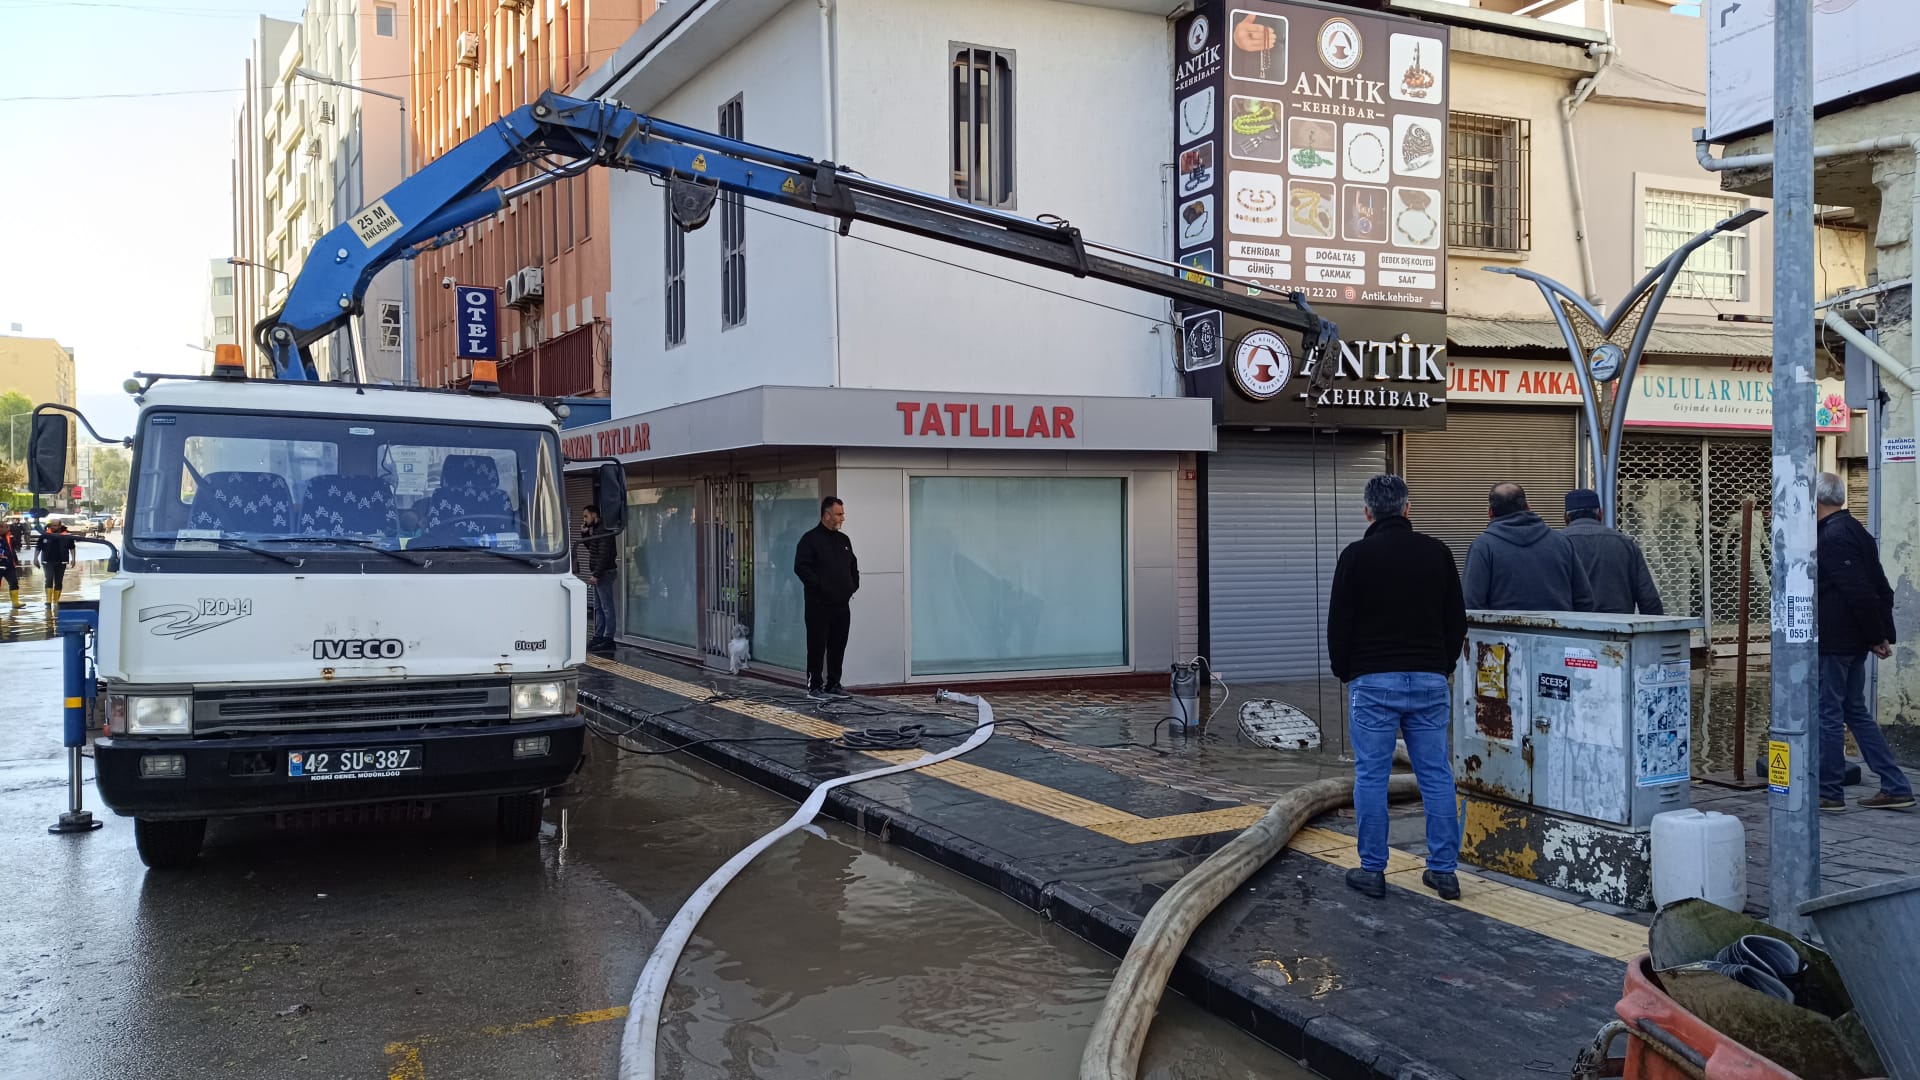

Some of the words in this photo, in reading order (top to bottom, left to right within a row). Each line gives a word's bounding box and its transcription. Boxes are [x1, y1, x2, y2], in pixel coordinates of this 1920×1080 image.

[1176, 44, 1220, 81] ANTİK
[1292, 71, 1386, 104] ANTİK
[1302, 101, 1375, 119] KEHRİBAR
[357, 215, 373, 230] 25
[373, 206, 386, 219] M
[361, 215, 397, 242] YAKLAŞMA
[1316, 251, 1341, 261] DOĞAL
[1343, 253, 1356, 264] TAŞ
[1247, 263, 1274, 277] GÜMÜŞ
[1320, 269, 1351, 280] ÇAKMAK
[1398, 275, 1416, 285] SAAT
[1312, 287, 1324, 297] 22
[1325, 288, 1337, 298] 20
[1361, 290, 1424, 303] Antik.kehribar
[466, 291, 488, 353] OTEL
[1516, 370, 1583, 396] AKKA
[1643, 375, 1731, 401] USLULAR
[1317, 386, 1430, 408] KEHRİBAR
[1673, 403, 1710, 413] Giyimde
[1714, 404, 1739, 414] kalite
[897, 401, 1076, 438] TATLILAR
[597, 423, 651, 457] TATLILAR
[199, 599, 252, 616] 120-14
[1789, 629, 1808, 639] 0551
[313, 639, 403, 660] IVECO
[1540, 676, 1568, 688] SCE354
[305, 753, 329, 772] 42
[340, 752, 364, 771] SU
[375, 749, 410, 769] 387
[358, 770, 400, 778] MÜDÜRLÜĞÜ
